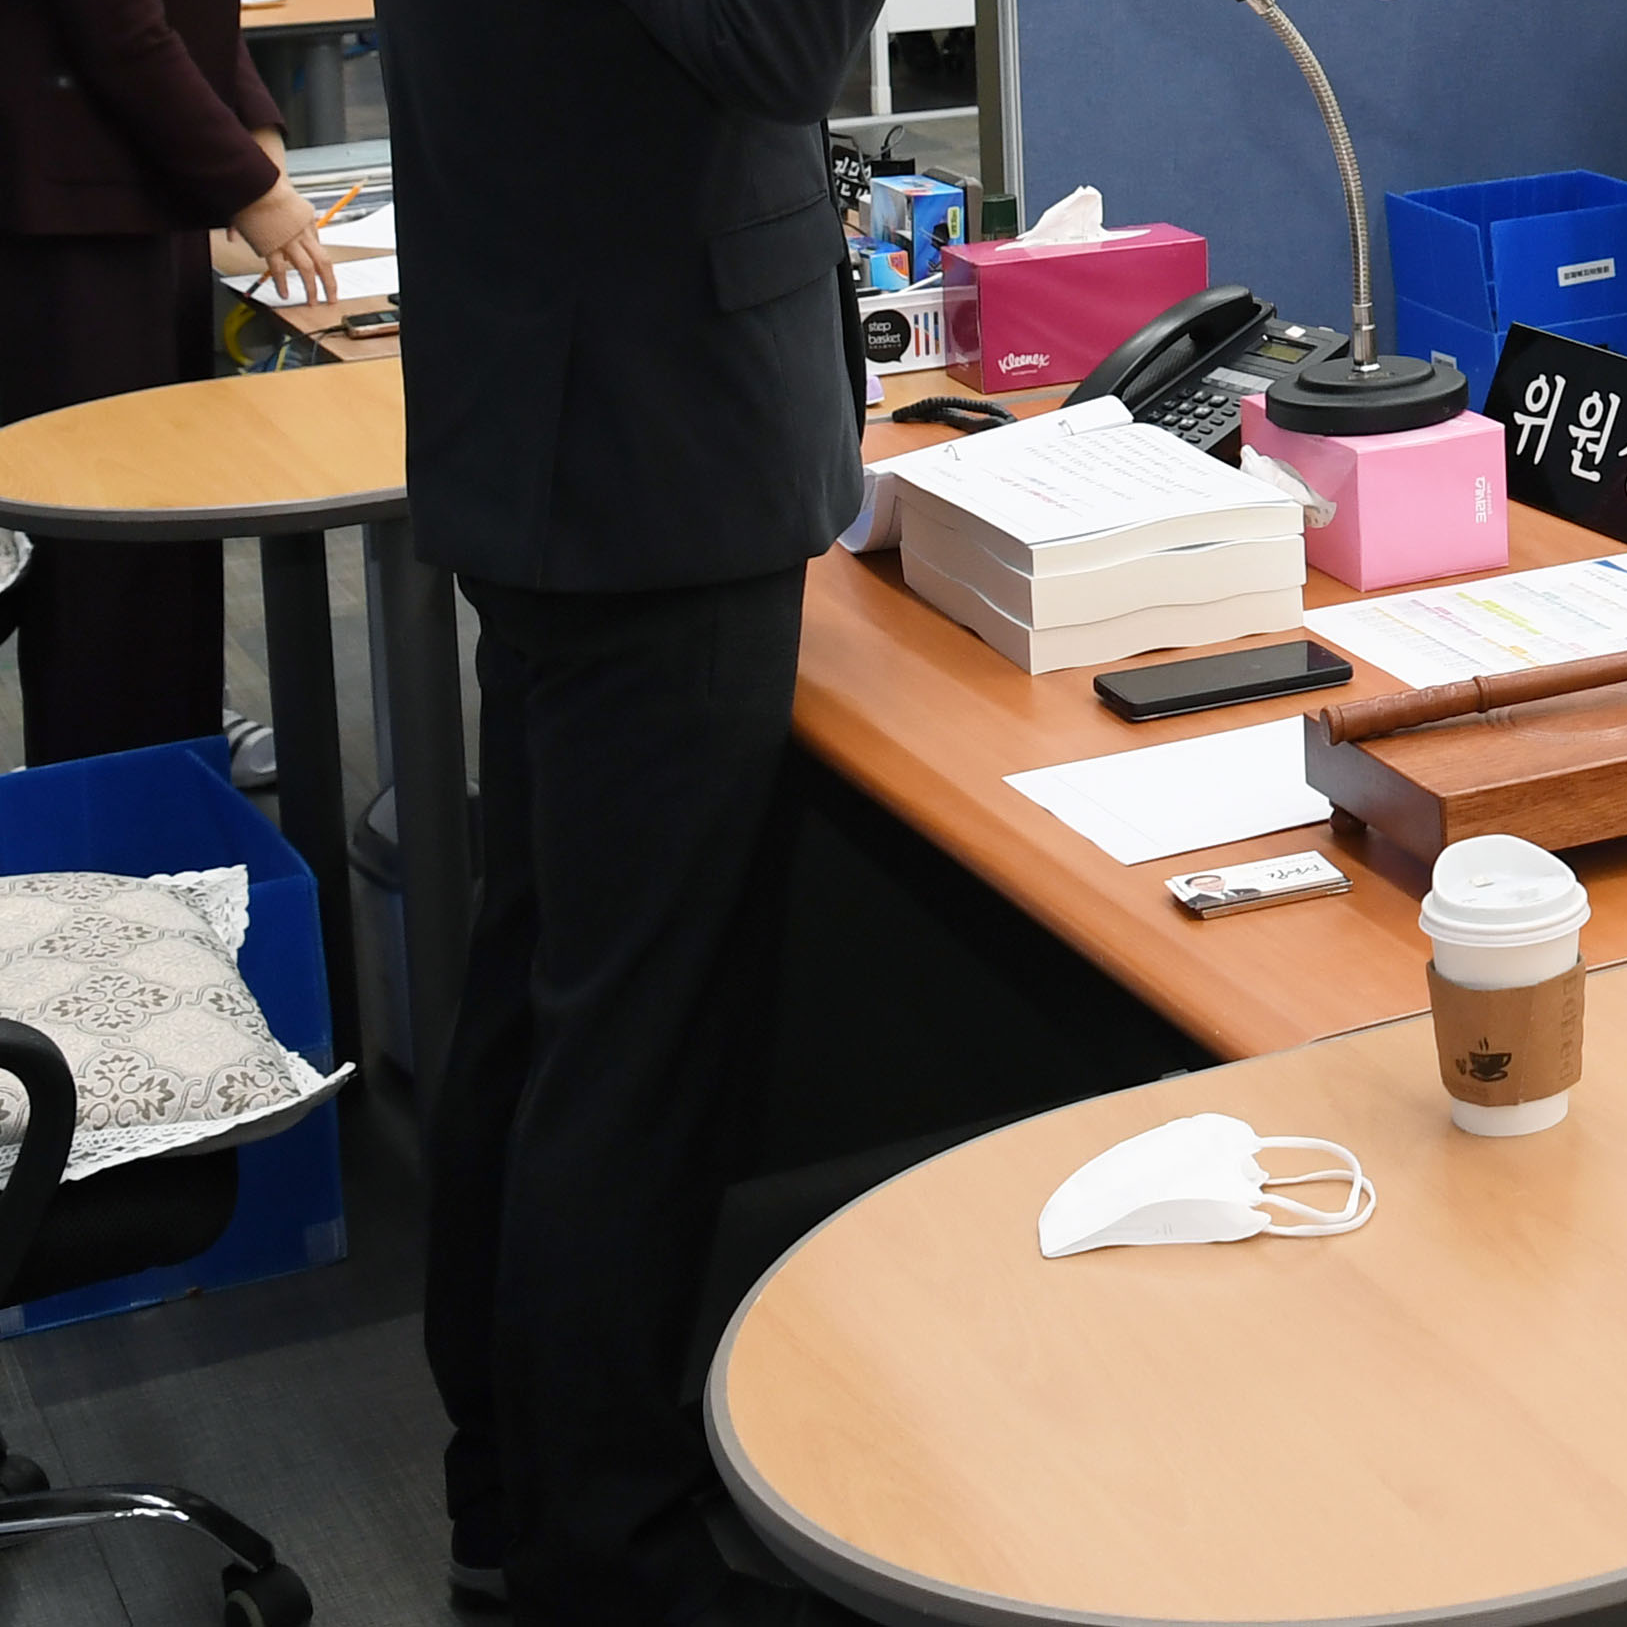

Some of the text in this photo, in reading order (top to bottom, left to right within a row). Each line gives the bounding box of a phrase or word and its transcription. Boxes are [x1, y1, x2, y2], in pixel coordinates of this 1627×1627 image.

[868, 322, 891, 332] step
[868, 333, 902, 345] basket
[998, 352, 1050, 373] Kleenex
